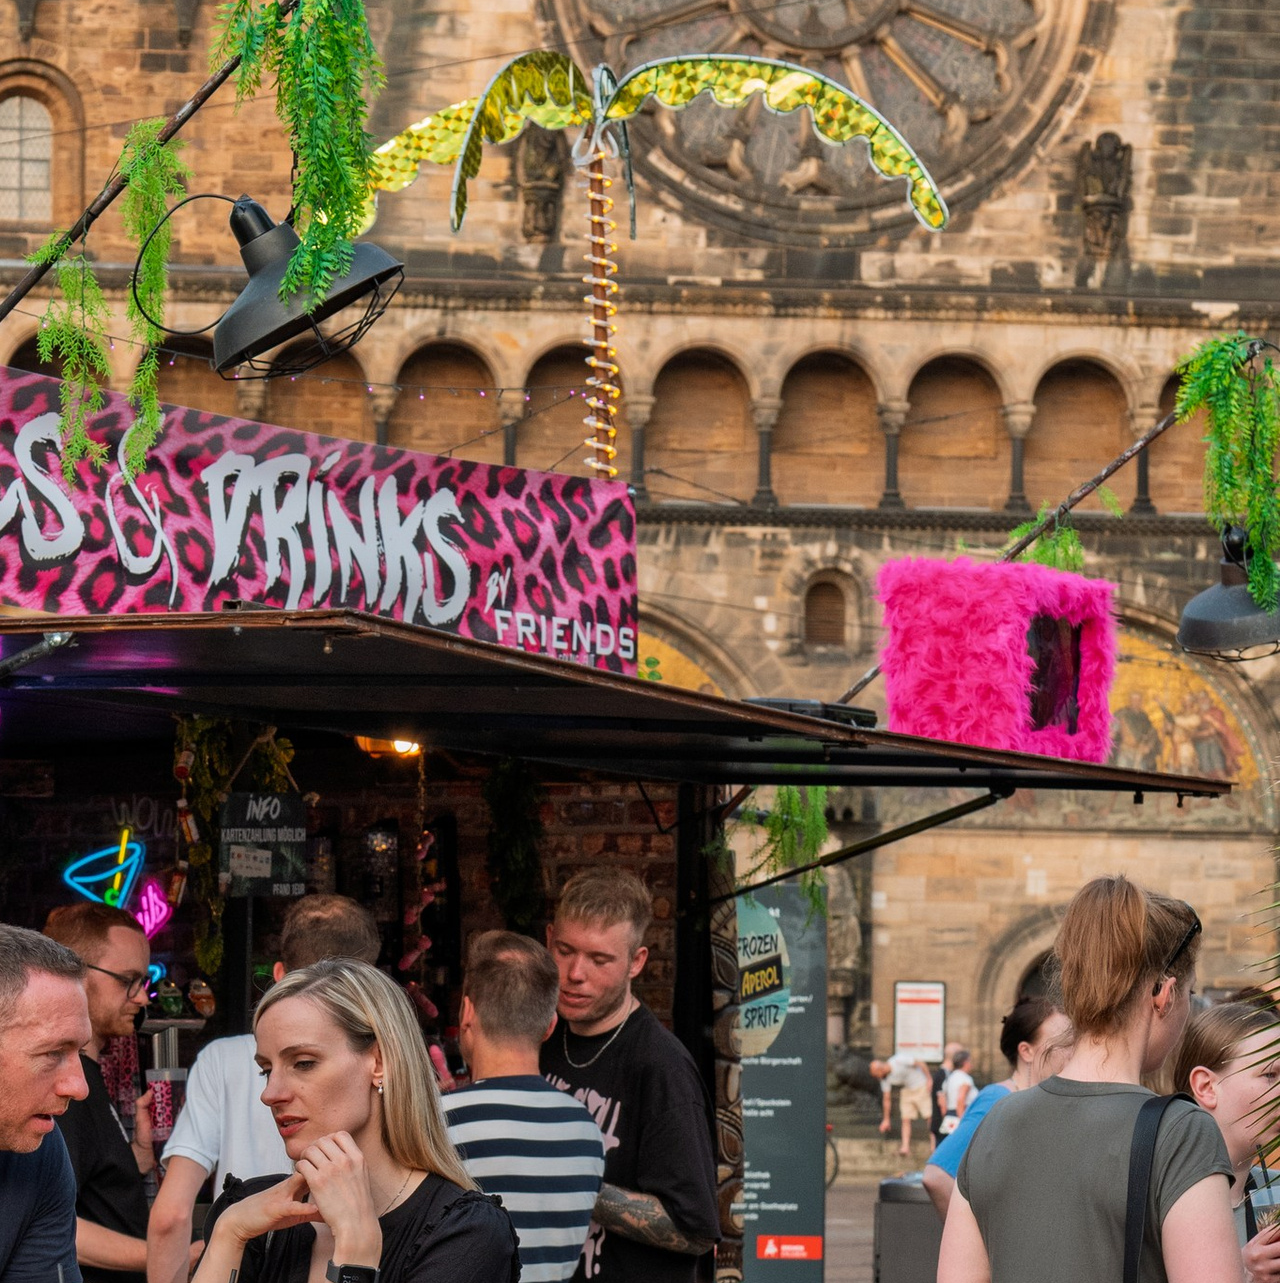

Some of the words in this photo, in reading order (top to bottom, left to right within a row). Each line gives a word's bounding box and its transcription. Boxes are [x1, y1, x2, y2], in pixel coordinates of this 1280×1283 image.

[201, 450, 472, 627] DRINKS
[483, 566, 512, 614] BY
[494, 608, 635, 660] FRIENDS
[246, 793, 281, 822] INFO
[221, 827, 277, 842] KARTENZAHLUNG
[277, 825, 307, 842] MÖGLICH
[272, 882, 291, 895] PFAND
[741, 966, 780, 997] APEROL
[744, 1004, 780, 1030] SPRITZ
